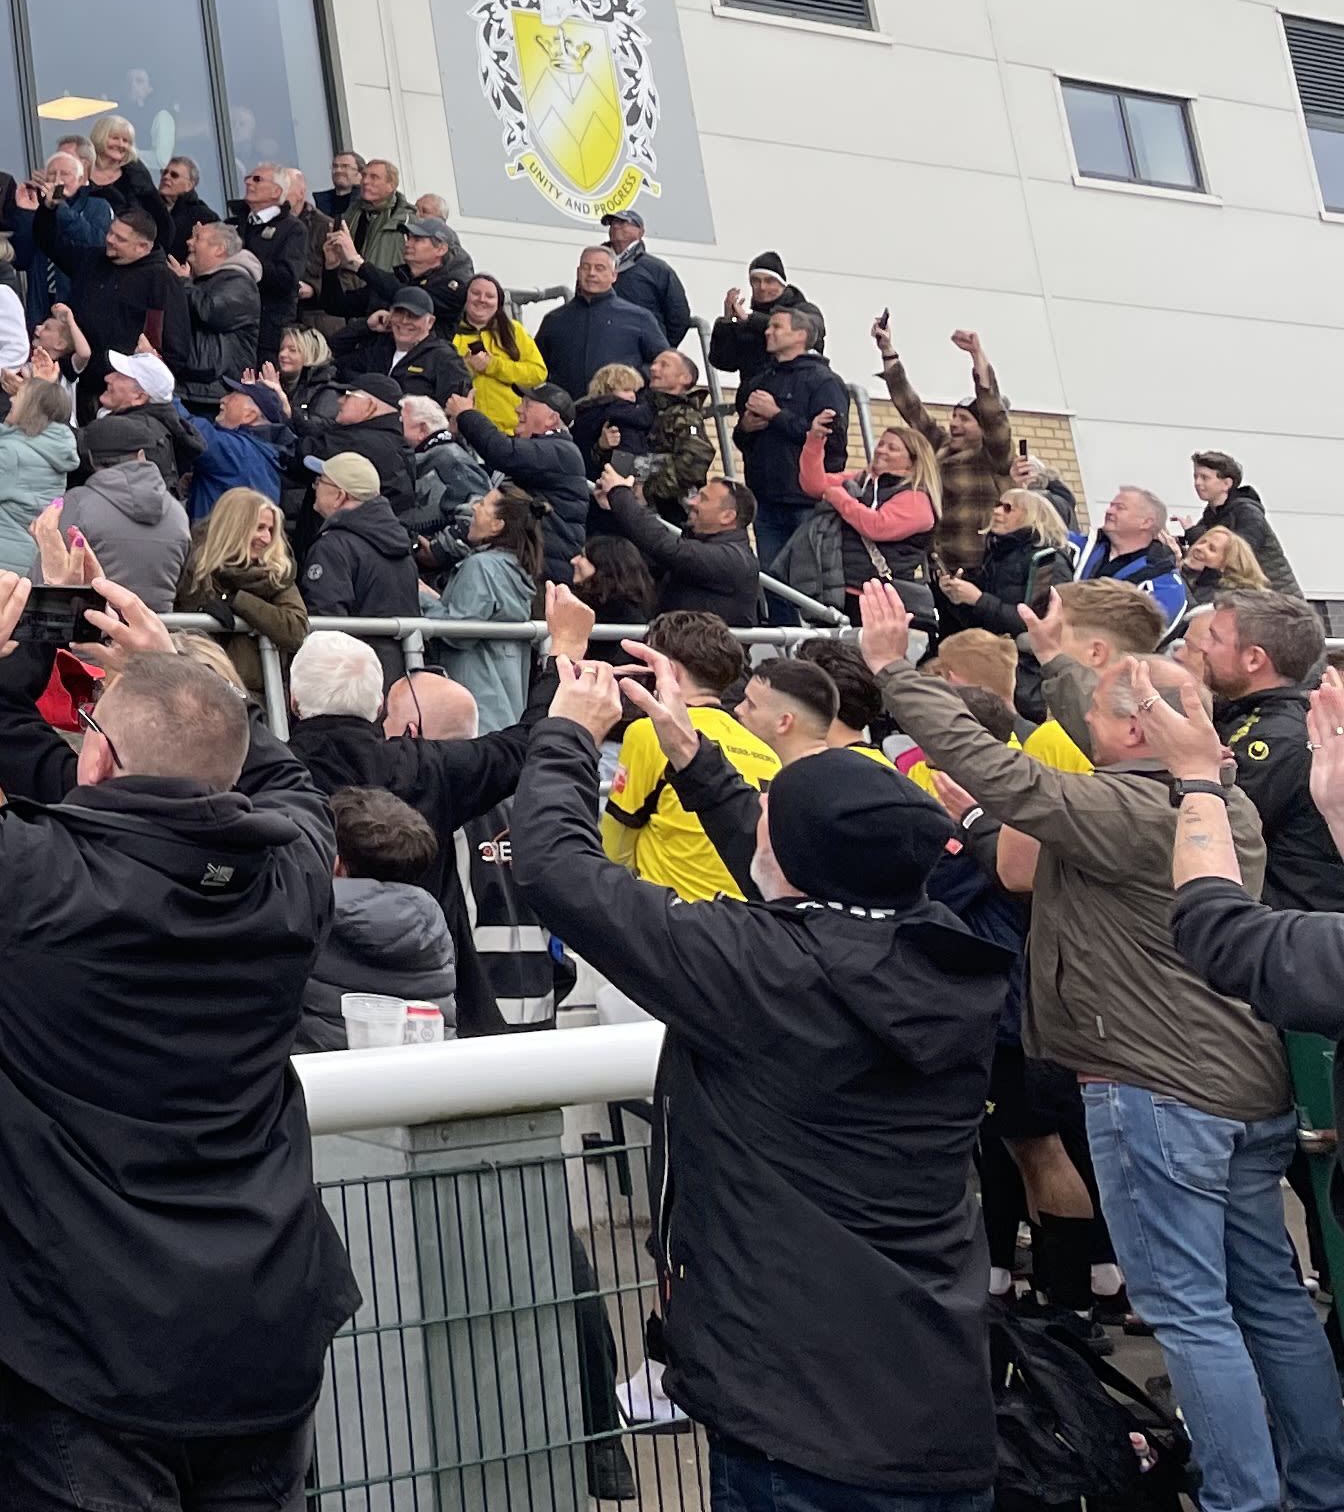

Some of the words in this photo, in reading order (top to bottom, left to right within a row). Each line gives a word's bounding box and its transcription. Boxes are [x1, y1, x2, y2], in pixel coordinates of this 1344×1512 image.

[528, 161, 563, 200] UNITY
[565, 197, 591, 215] AND
[593, 172, 637, 216] PROGRESS
